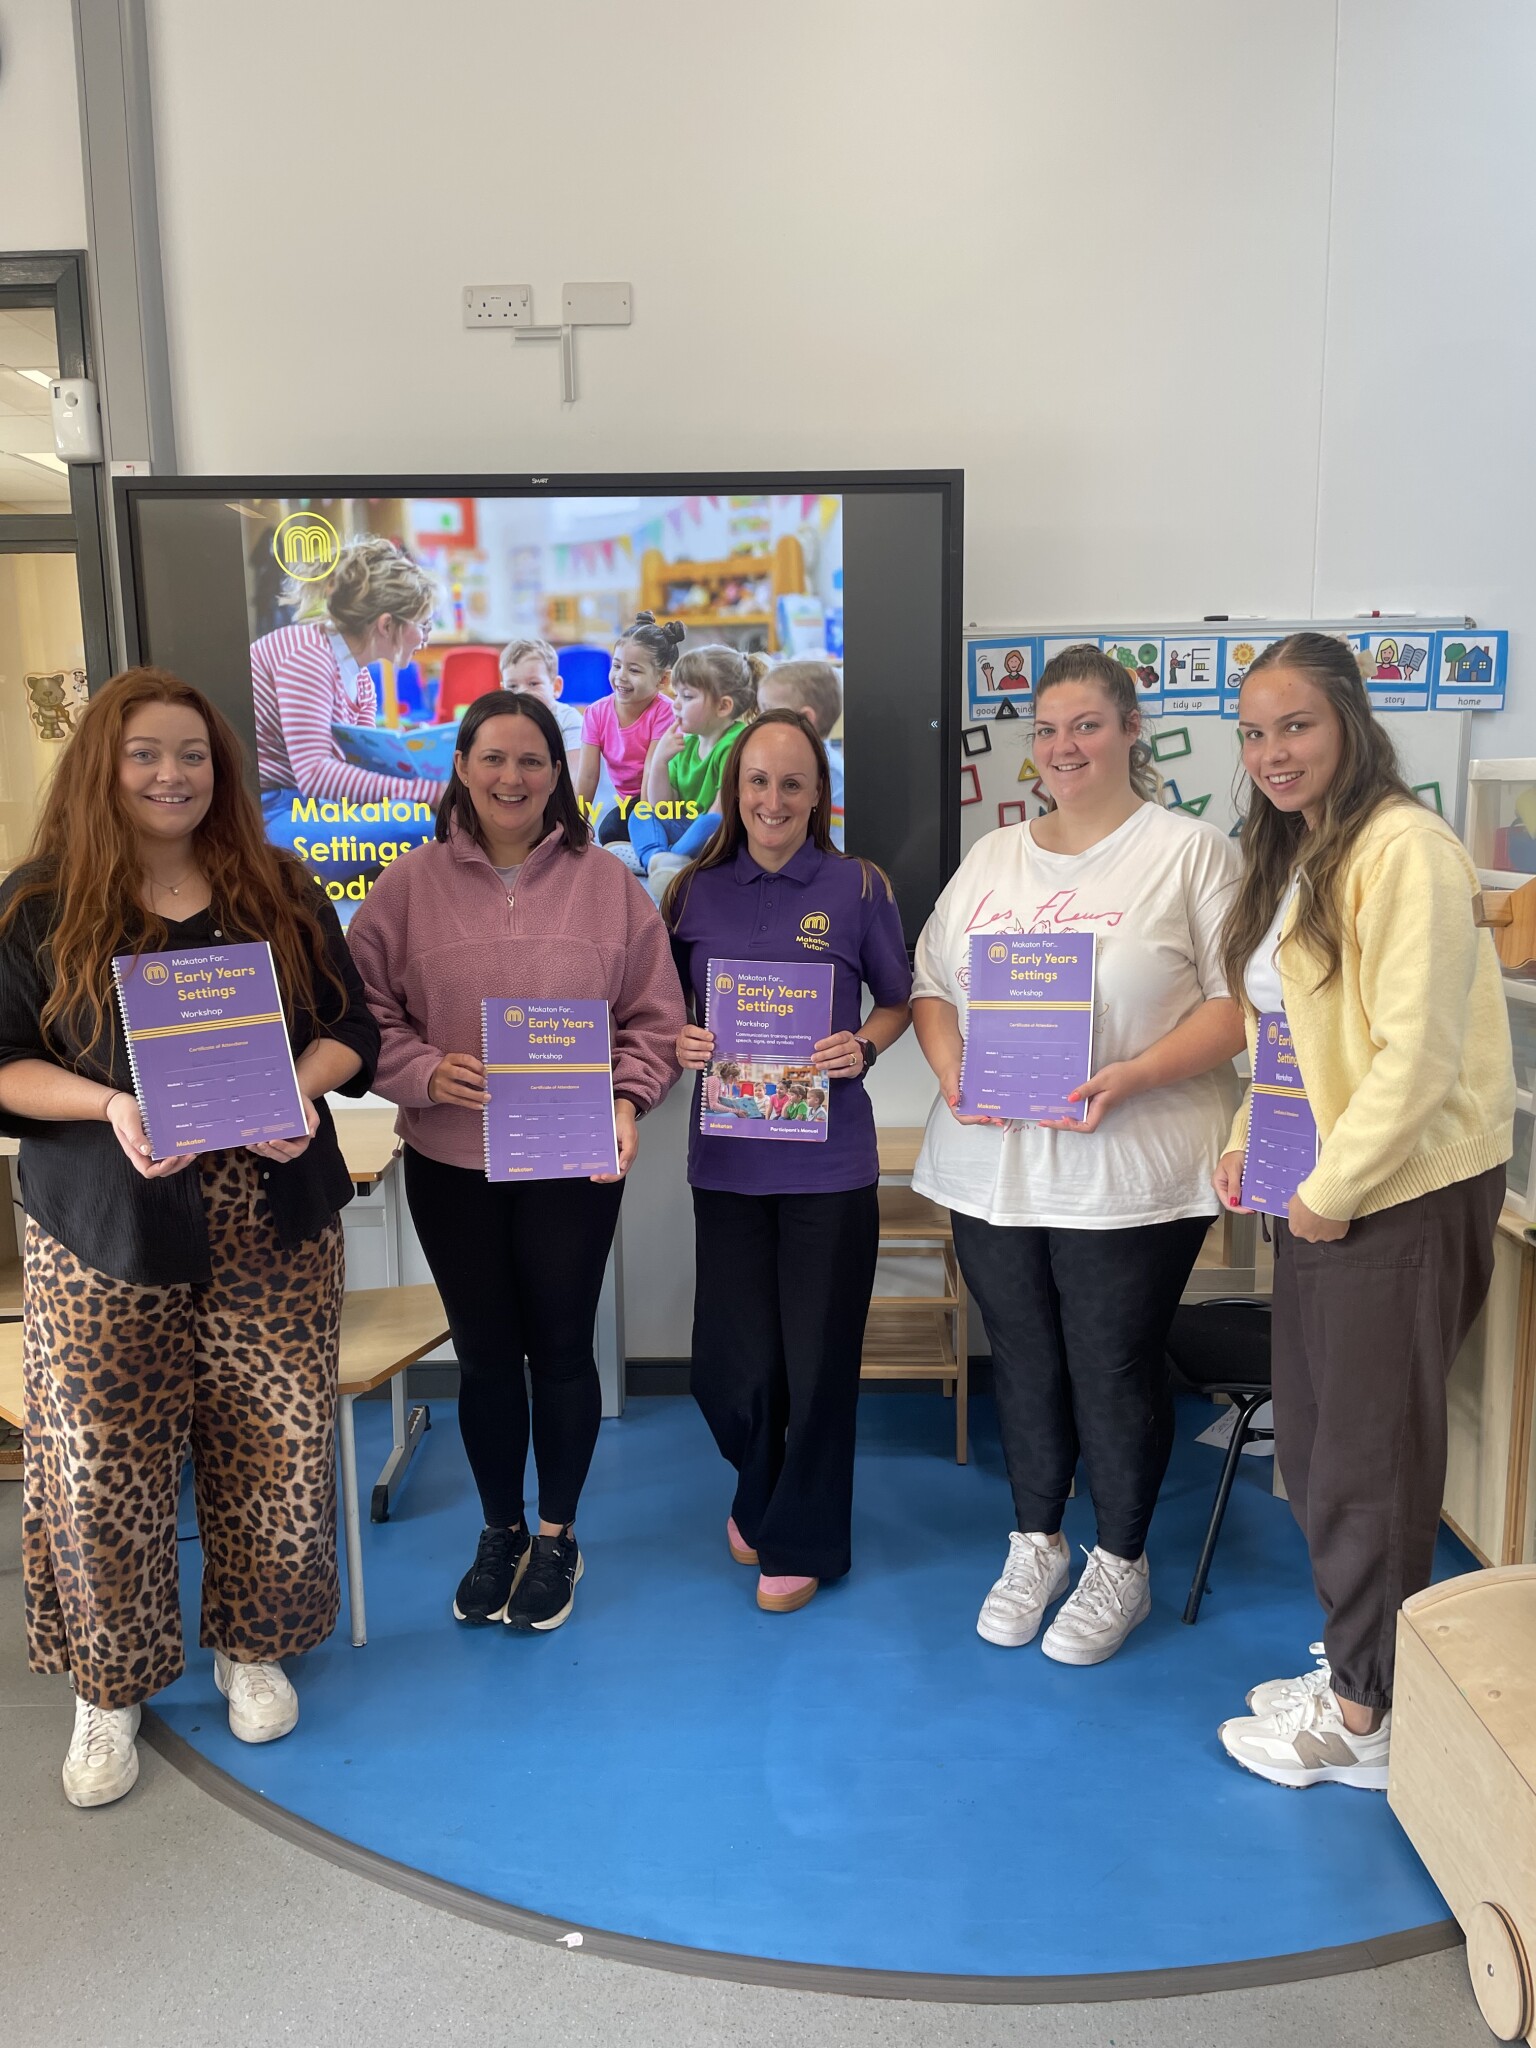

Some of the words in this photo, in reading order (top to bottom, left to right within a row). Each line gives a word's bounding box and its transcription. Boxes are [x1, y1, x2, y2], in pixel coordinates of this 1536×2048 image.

[1173, 701, 1189, 710] tidy
[1192, 701, 1202, 709] up
[1384, 696, 1405, 705] story
[1457, 697, 1482, 706] home
[976, 706, 996, 716] good
[291, 797, 431, 823] Makaton
[614, 795, 699, 820] Years
[795, 935, 830, 948] Makaton
[802, 942, 824, 952] Tutor
[171, 957, 208, 966] Makaton
[1011, 953, 1042, 967] Early
[1045, 953, 1078, 964] Years
[174, 969, 213, 984] Early
[215, 967, 256, 979] Years
[737, 973, 766, 982] Makaton
[1010, 969, 1058, 983] Settings
[178, 986, 237, 1001] Settings
[737, 983, 774, 1000] Early
[778, 985, 818, 999] Years
[1009, 989, 1043, 997] Workshop
[180, 1008, 223, 1019] Workshop
[737, 999, 794, 1017] Settings
[528, 1017, 559, 1031] Early
[562, 1018, 594, 1028] Years
[735, 1020, 770, 1029] Workshop
[528, 1033, 576, 1047] Settings
[528, 1052, 563, 1060] Workshop
[1277, 1052, 1298, 1067] Setting
[176, 1138, 206, 1147] Makaton
